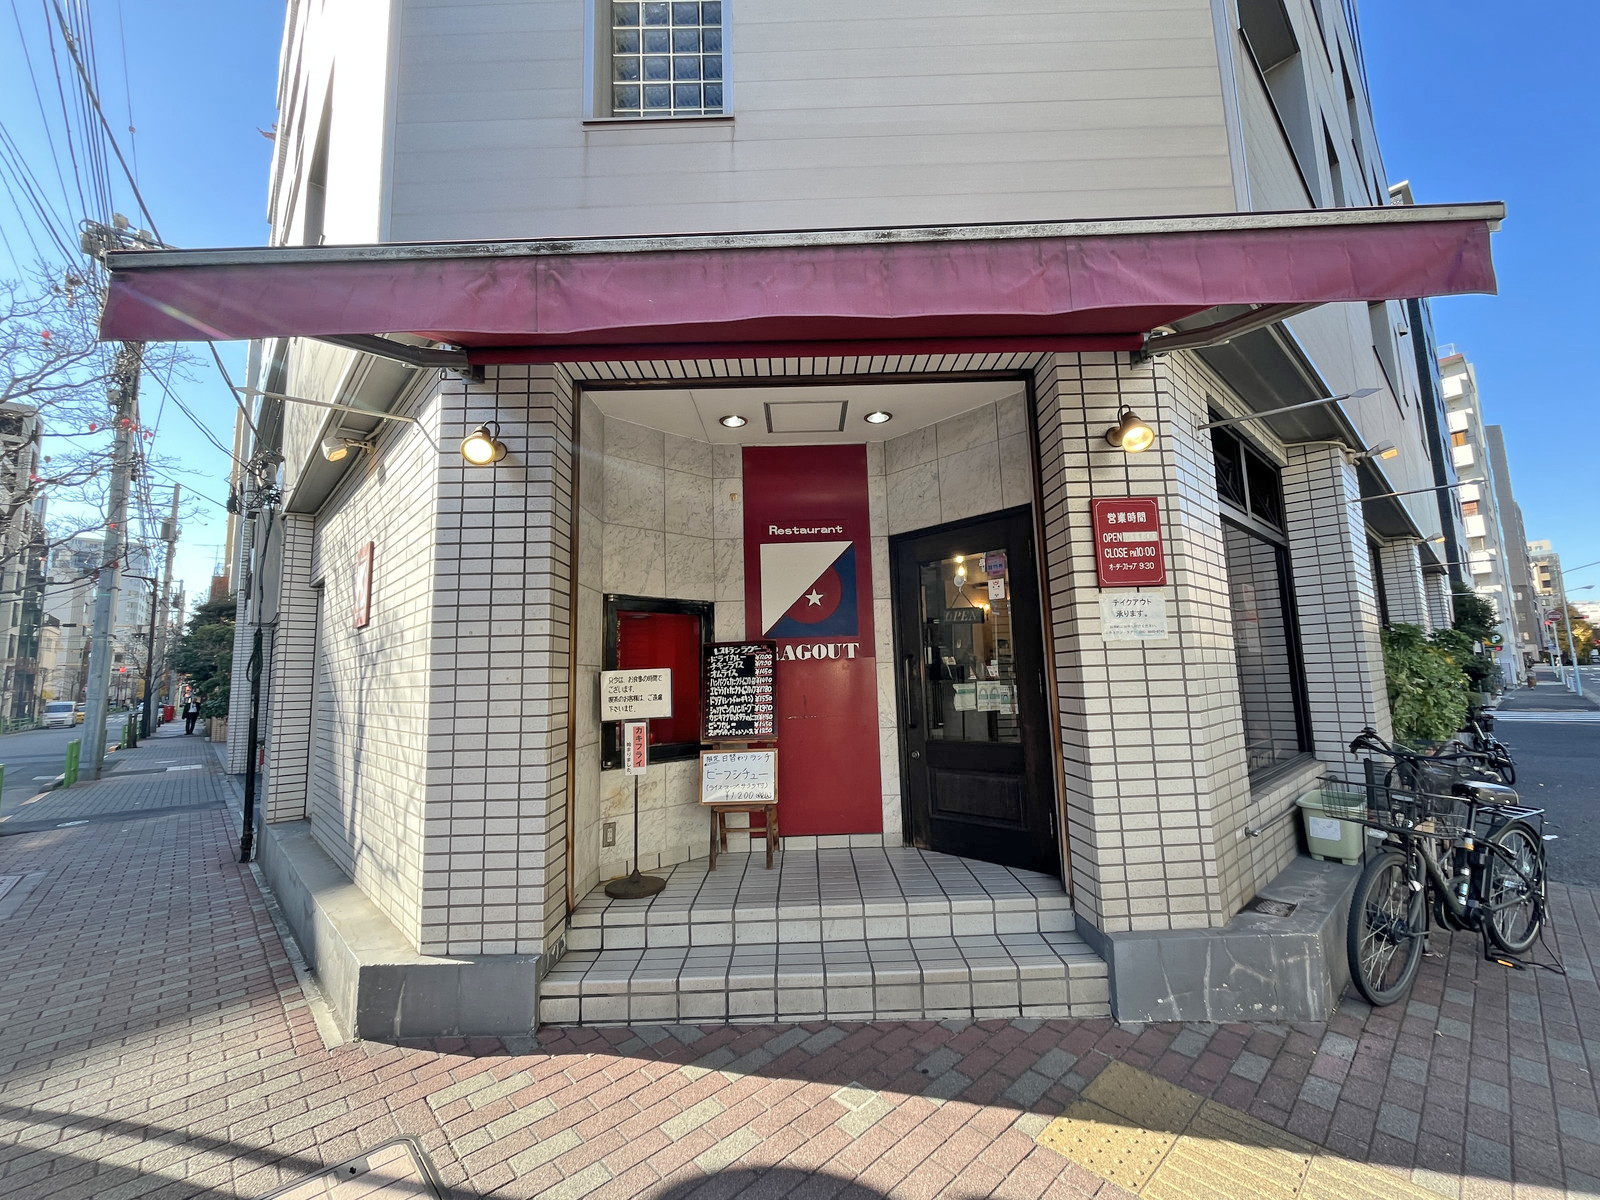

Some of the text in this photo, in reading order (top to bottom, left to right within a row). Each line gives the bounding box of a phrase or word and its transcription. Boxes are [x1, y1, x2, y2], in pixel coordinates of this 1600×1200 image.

[1107, 511, 1147, 524] 営業時間
[768, 525, 843, 536] Restaurant
[1103, 532, 1123, 543] OPEN
[1104, 547, 1129, 559] CLOSE
[1111, 598, 1152, 607] テイクアウト
[777, 642, 859, 661] AGOUT
[709, 661, 745, 671] チキンライス
[710, 669, 739, 678] オムライス
[635, 726, 643, 767] カキフライ
[706, 768, 769, 780] ビーフシチュー
